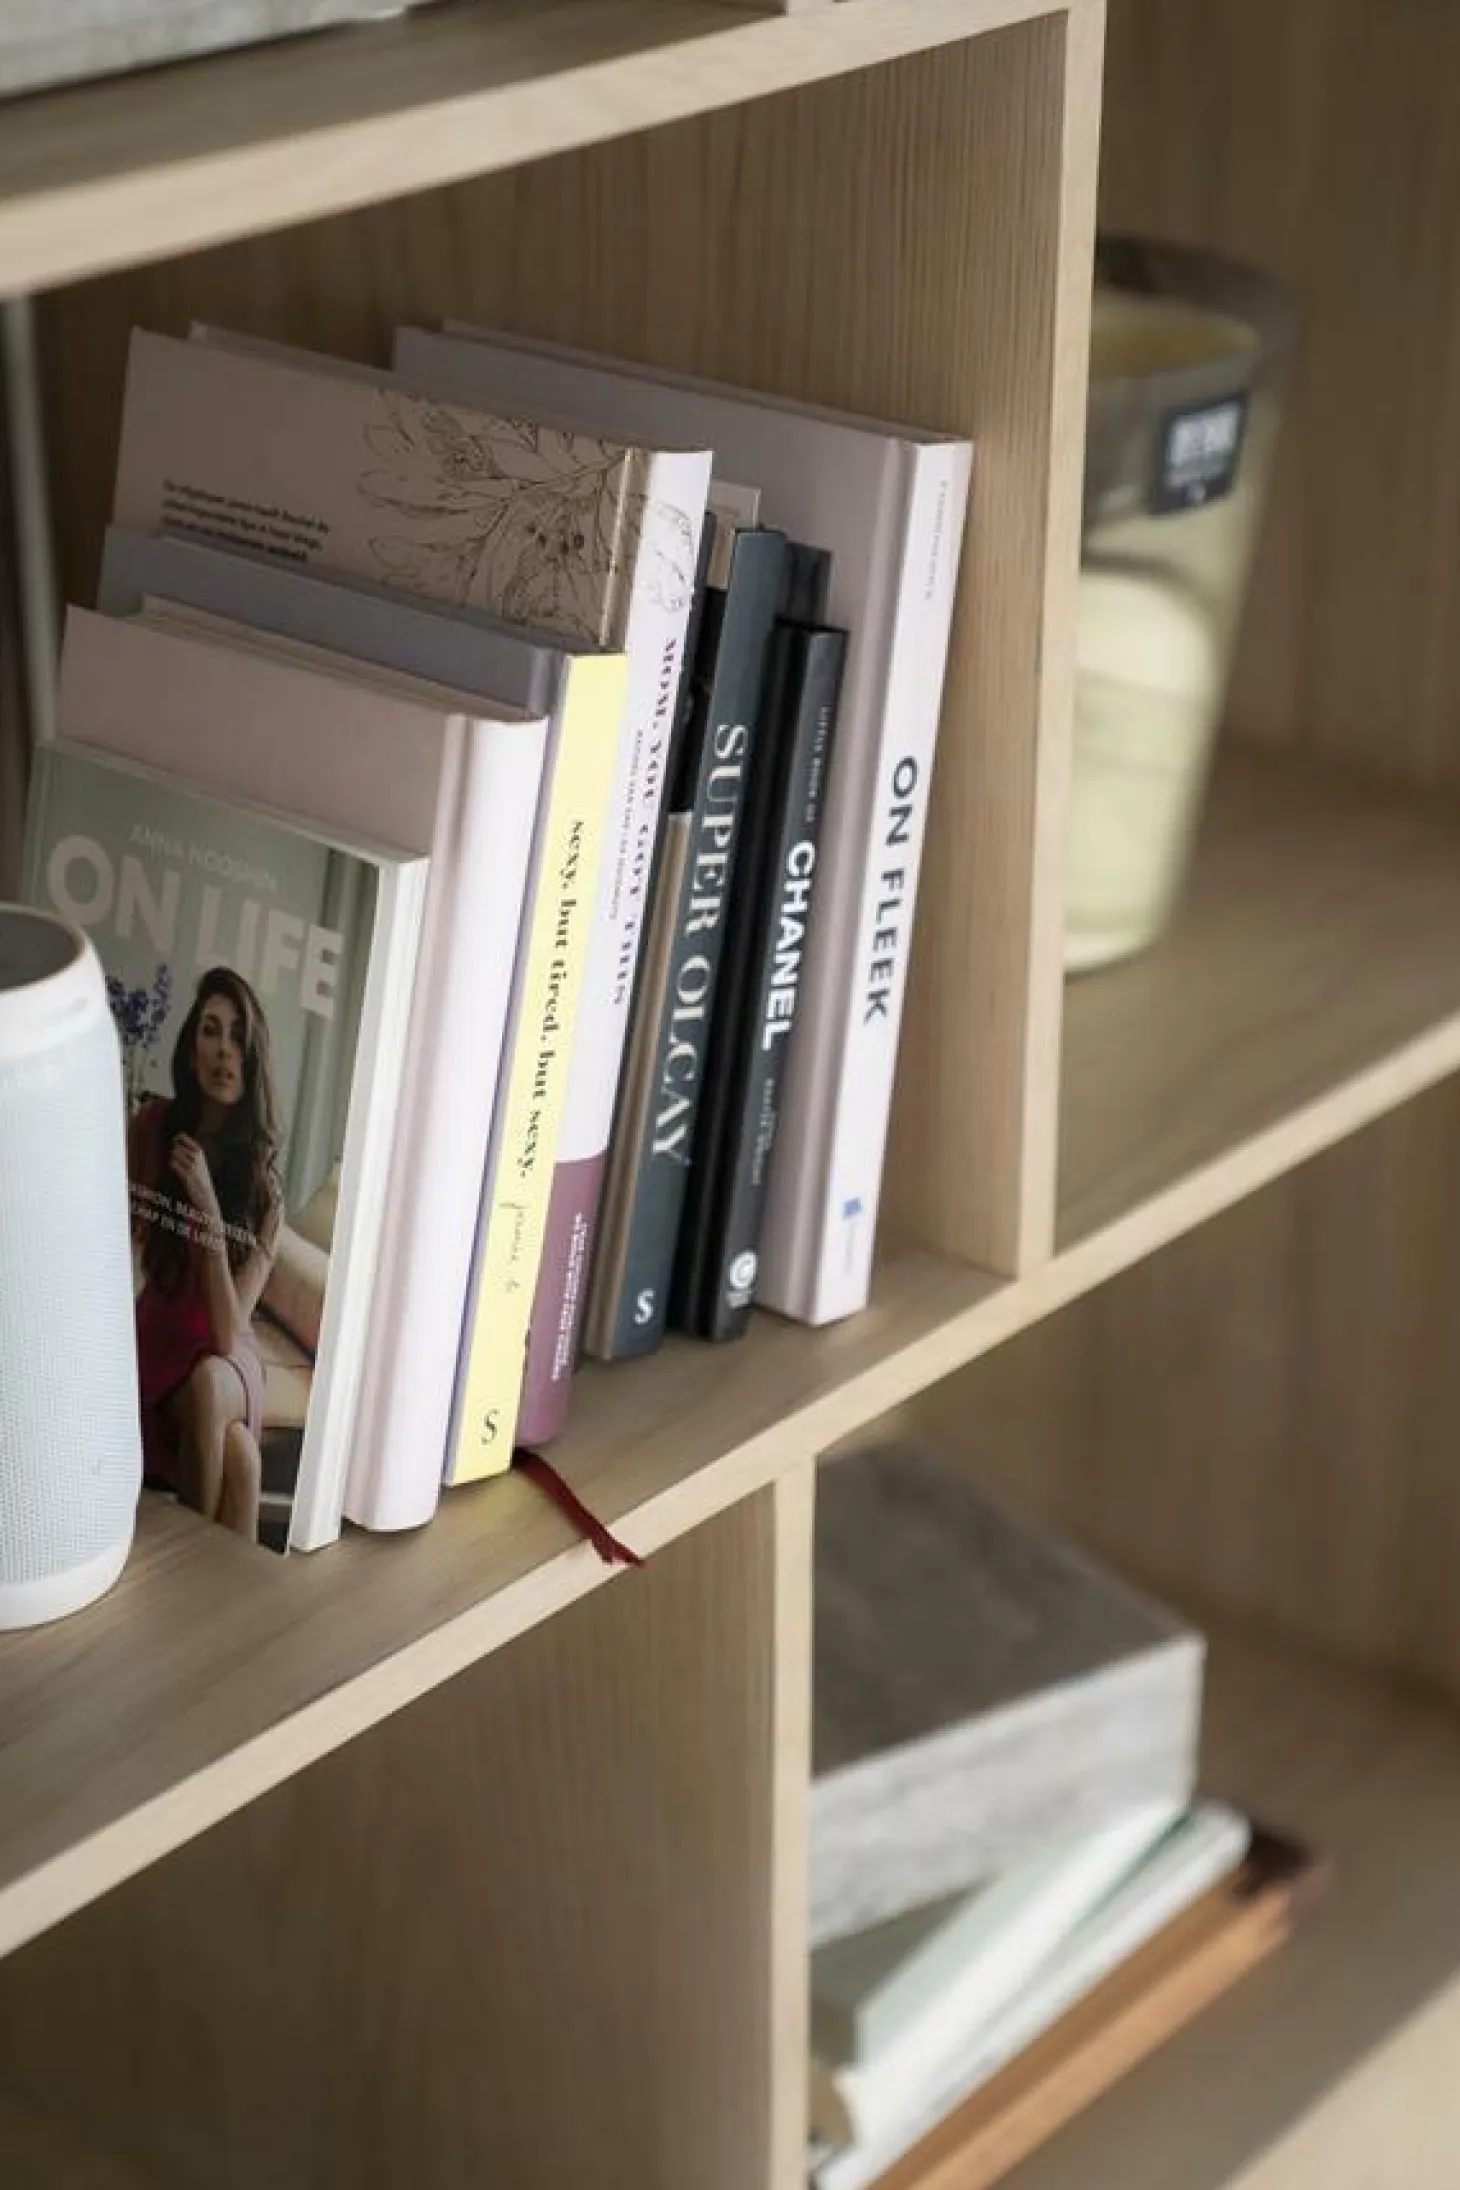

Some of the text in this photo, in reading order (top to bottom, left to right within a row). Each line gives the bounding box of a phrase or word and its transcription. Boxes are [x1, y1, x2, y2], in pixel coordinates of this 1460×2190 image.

[49, 834, 346, 1018] ON LIFE
[555, 899, 577, 948] but
[652, 723, 748, 1164] SUPER OLCAY
[761, 841, 817, 1051] CHANEL
[864, 755, 918, 1026] ON FLEEK
[533, 1050, 555, 1098] but
